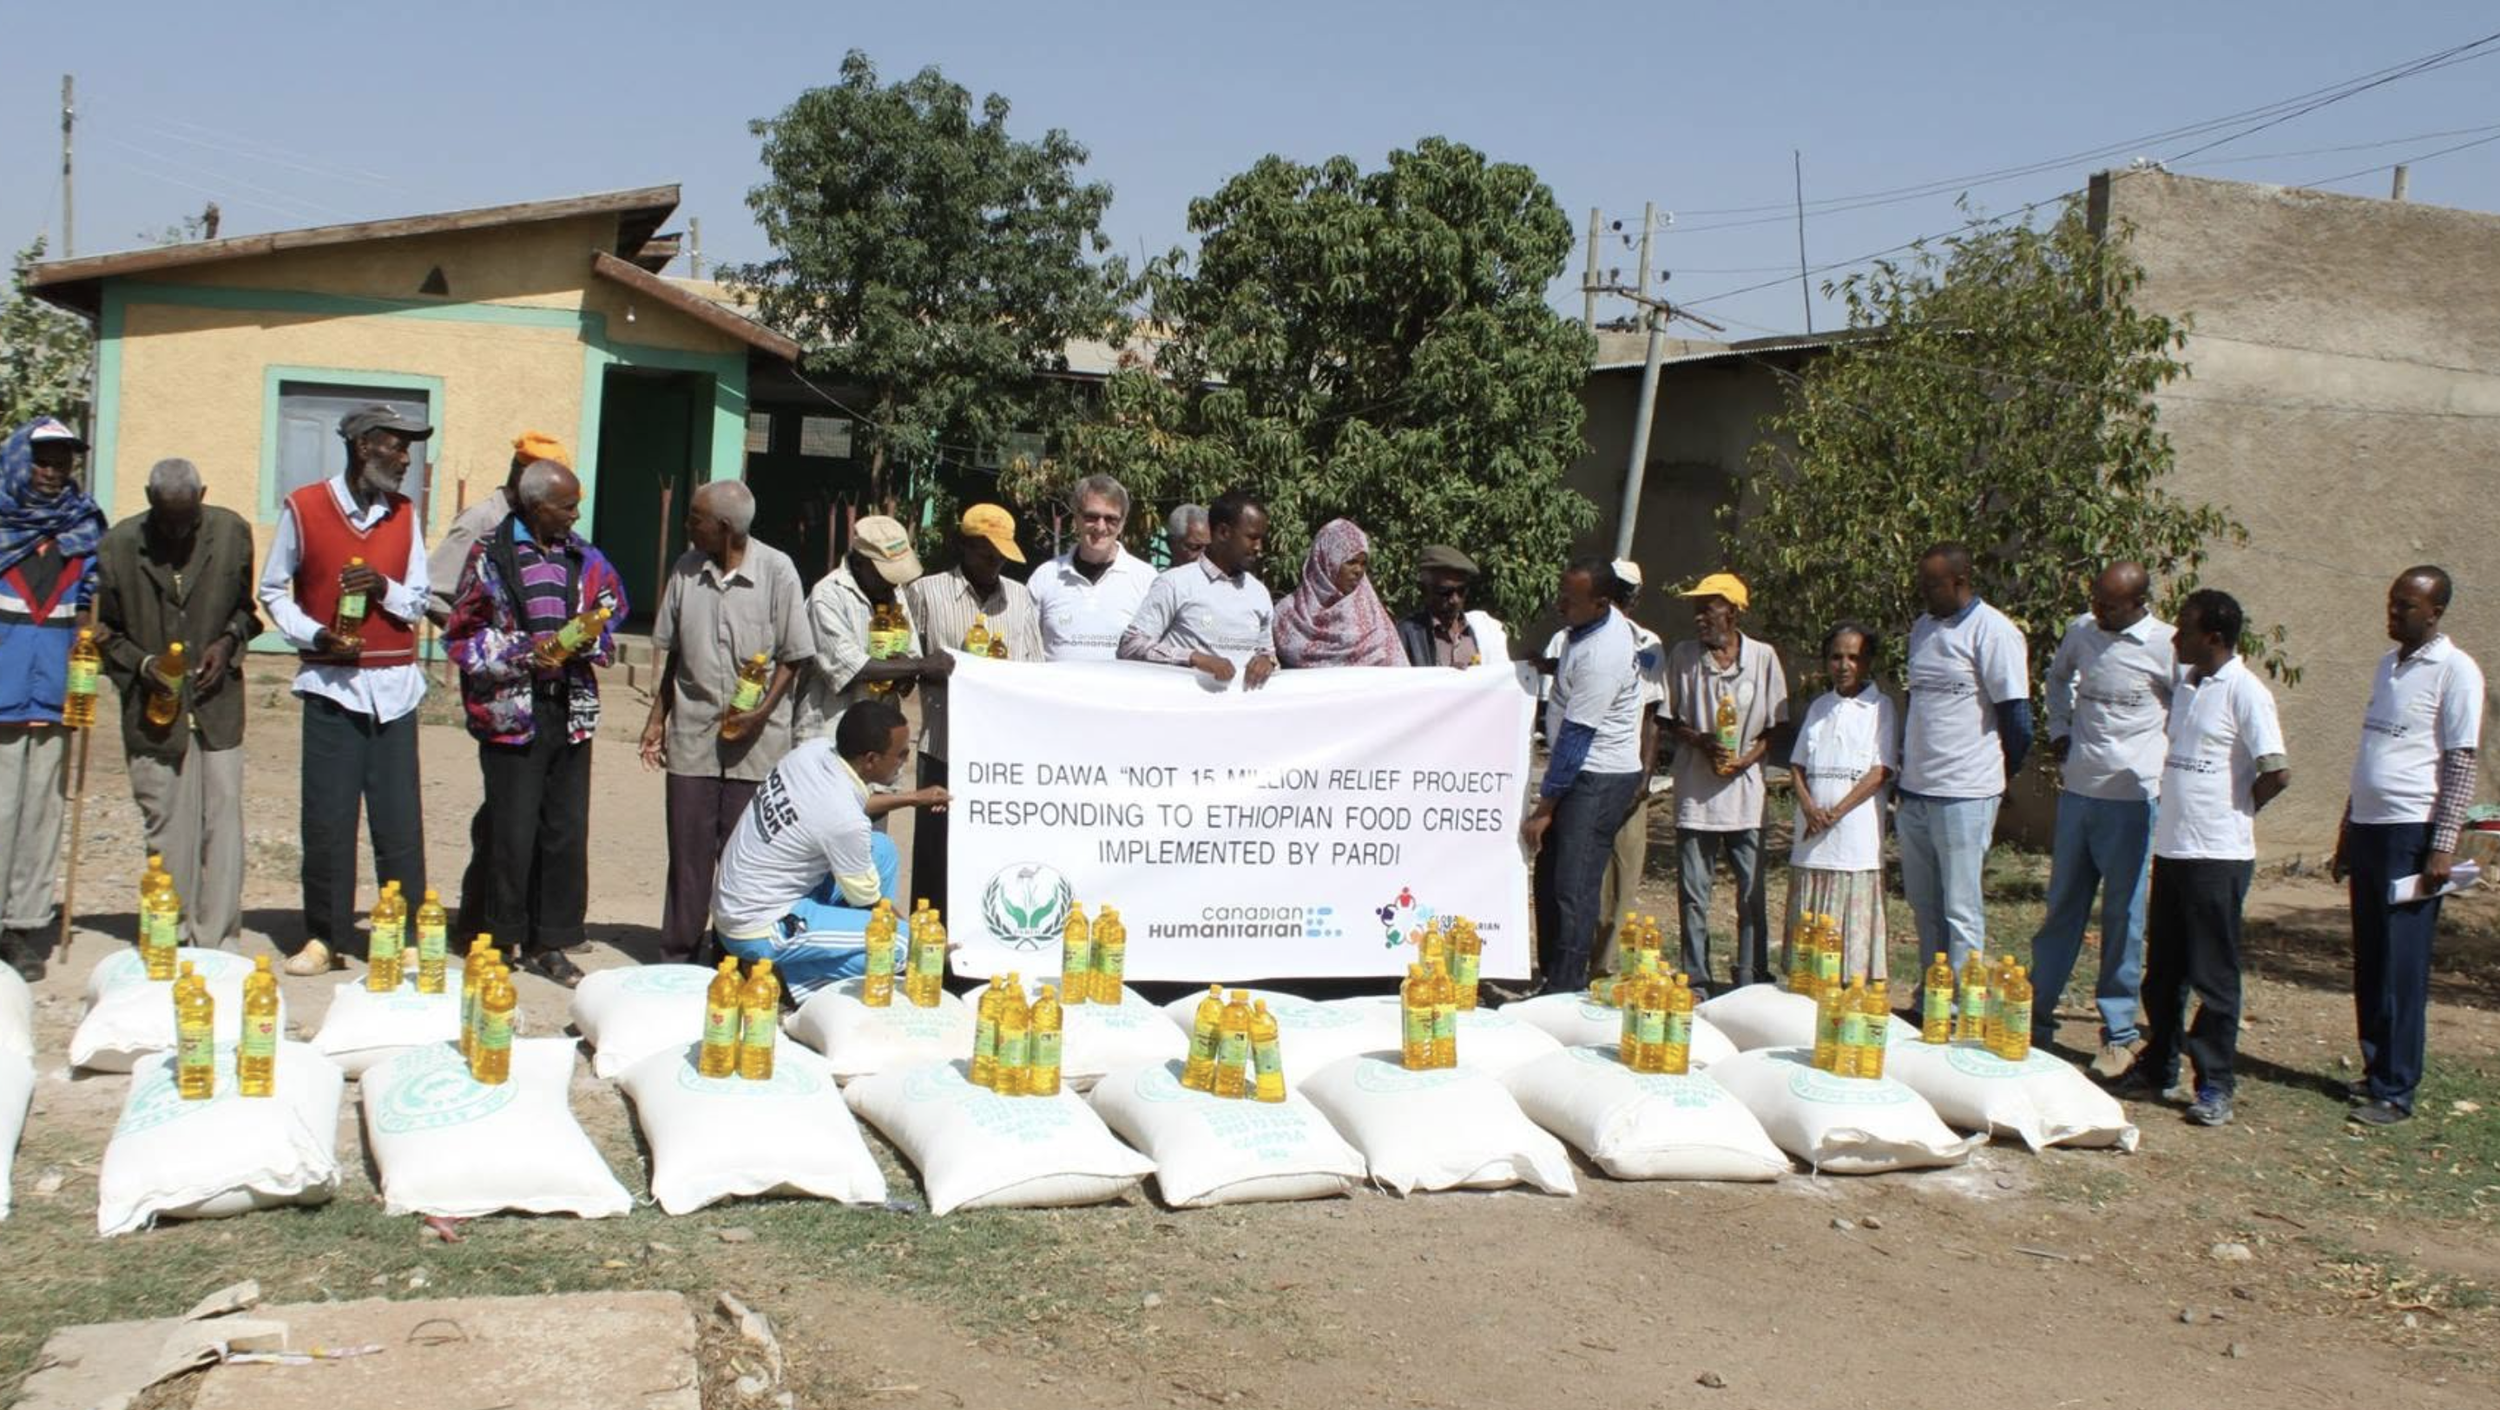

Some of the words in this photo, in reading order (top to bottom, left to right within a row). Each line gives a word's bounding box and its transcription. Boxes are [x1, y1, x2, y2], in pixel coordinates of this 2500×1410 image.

[767, 767, 786, 798] OT
[968, 762, 1024, 785] DIRE
[1037, 763, 1108, 786] DAWA
[1192, 769, 1216, 786] 15
[1227, 769, 1319, 790] MLION
[1328, 769, 1401, 791] RELIEF
[969, 800, 1144, 828] RESPONDING
[1157, 803, 1194, 829] TO
[1206, 804, 1333, 830] ETHIOPIAN
[1346, 806, 1412, 831] FOOD
[1423, 807, 1503, 832] CRISES
[1098, 839, 1276, 865] IMPLEMENTED
[1288, 841, 1320, 866] BY
[1332, 842, 1401, 866] PARDI
